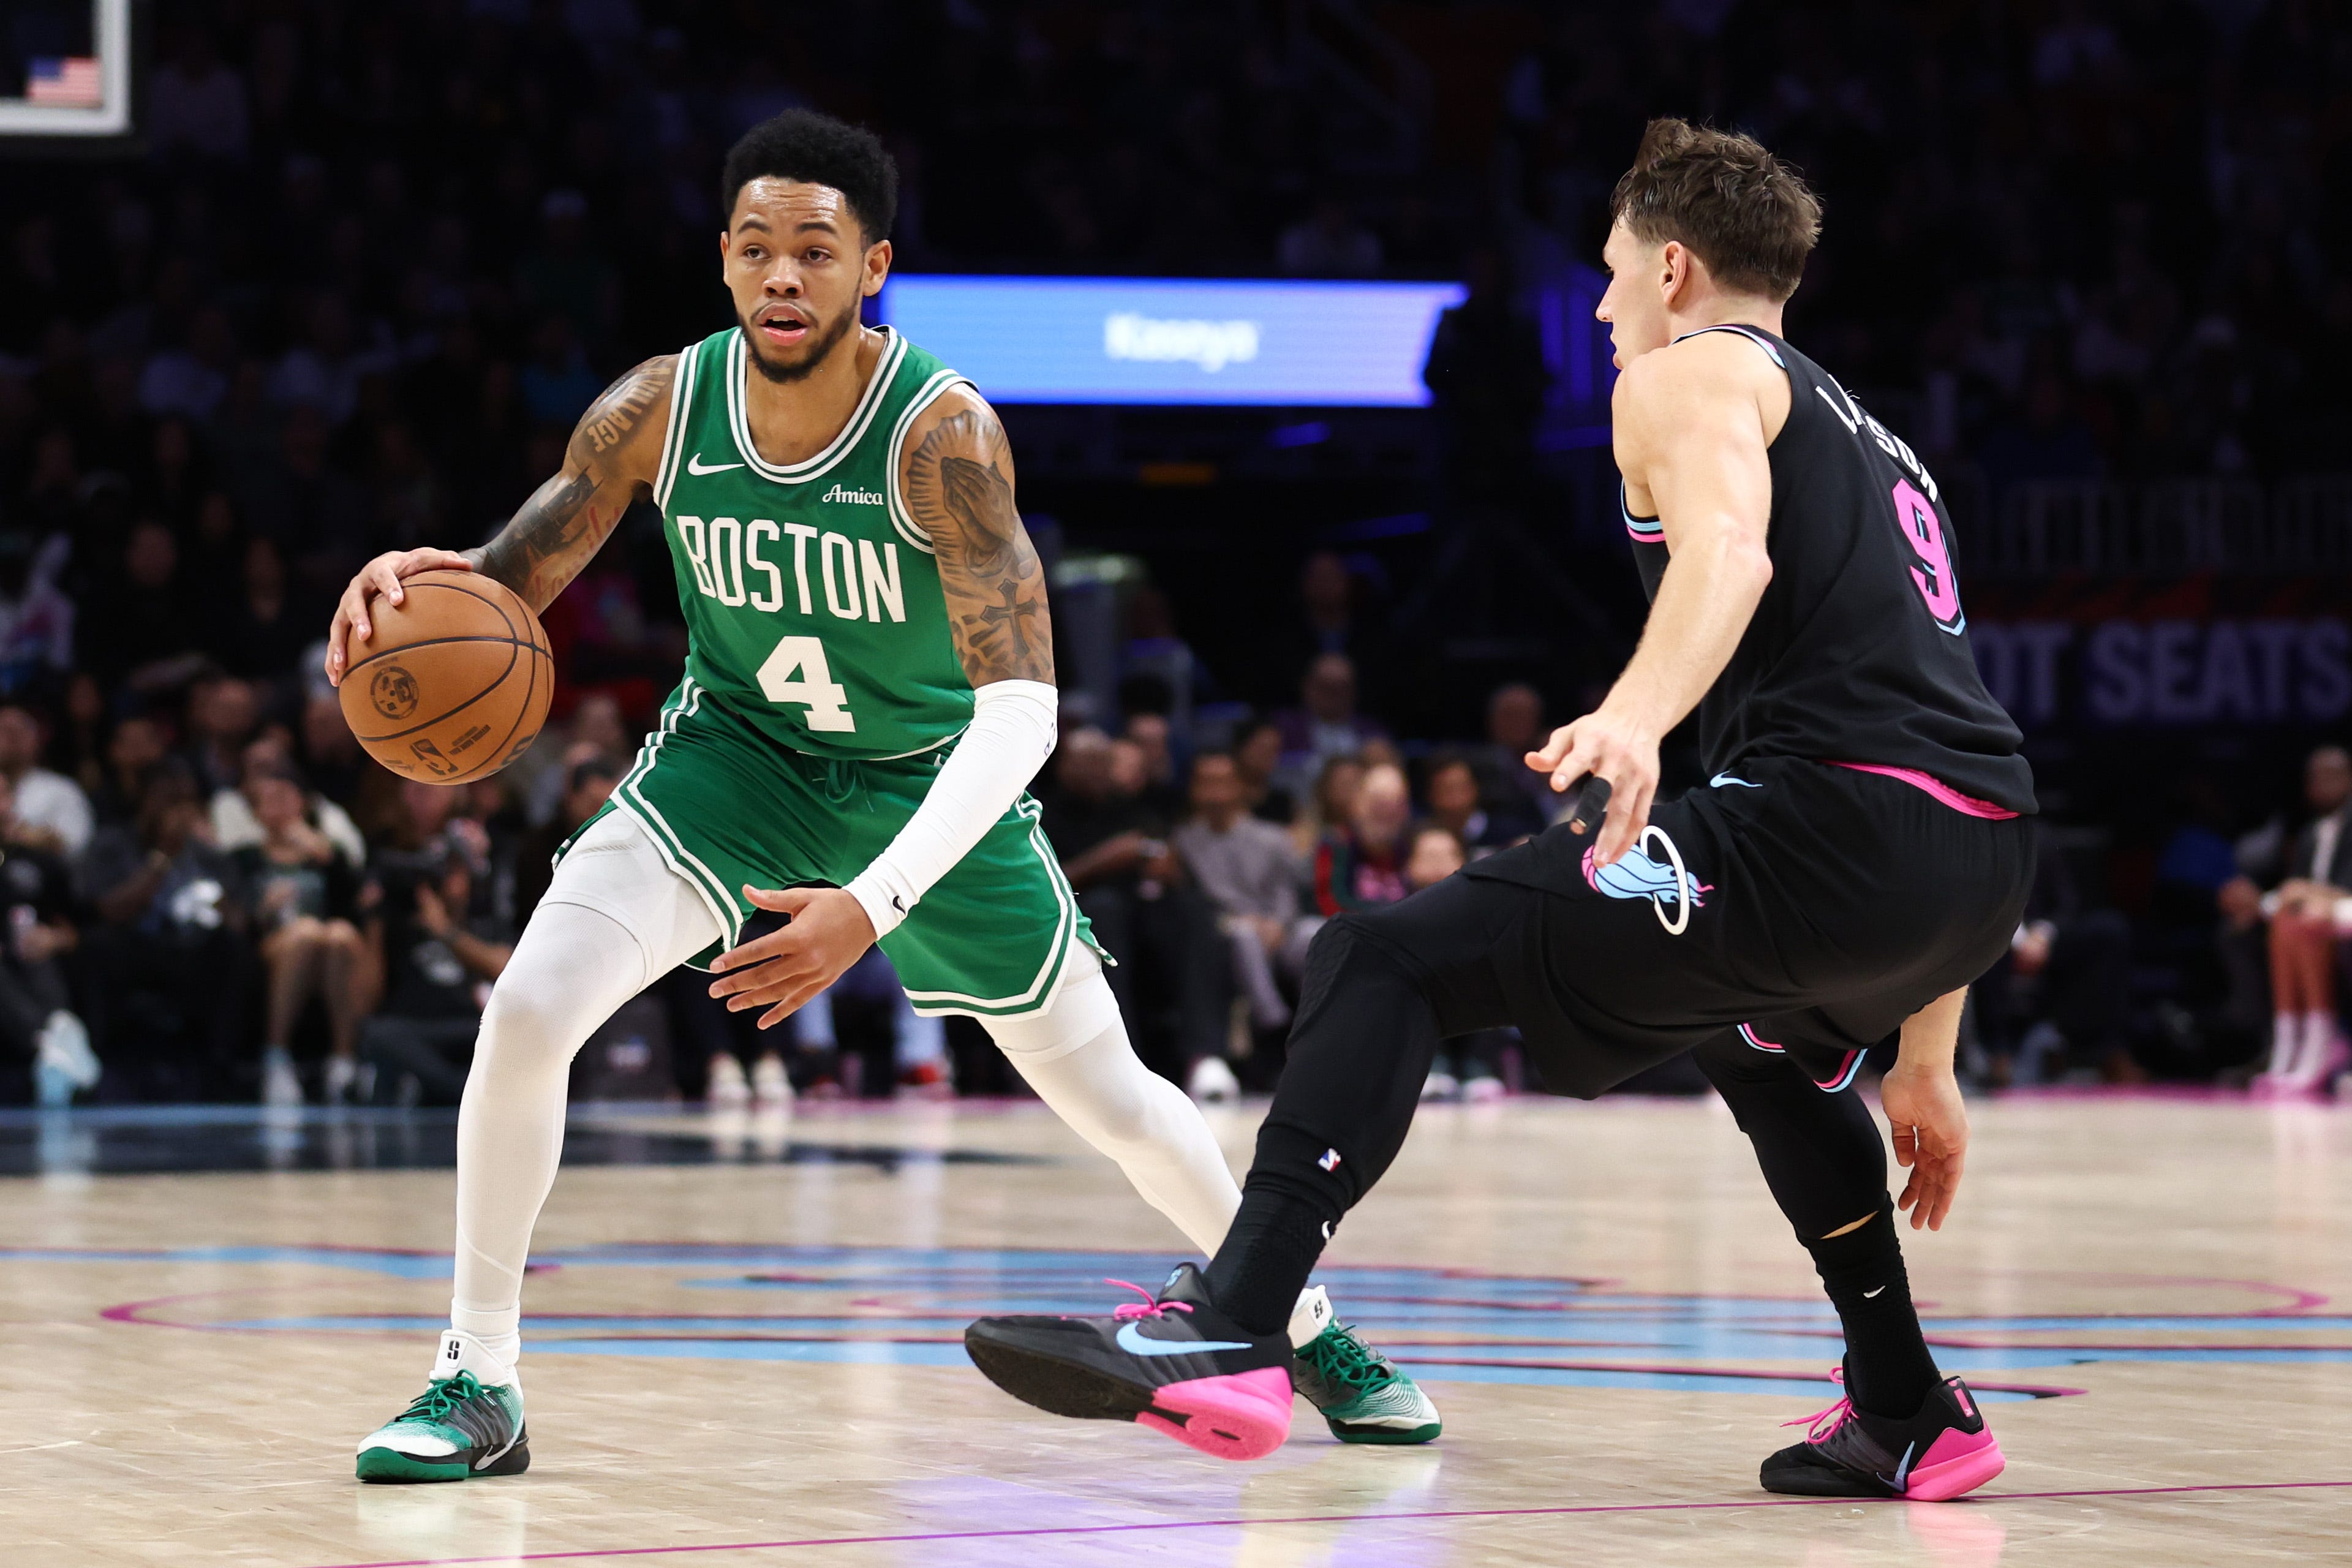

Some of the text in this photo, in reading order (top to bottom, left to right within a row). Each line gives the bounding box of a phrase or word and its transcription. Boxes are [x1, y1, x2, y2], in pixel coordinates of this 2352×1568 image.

[822, 484, 884, 505] Amica
[676, 515, 907, 623] BOSTON
[1892, 478, 1966, 636] 9
[755, 635, 856, 733] 4
[2089, 617, 2352, 722] SEATS
